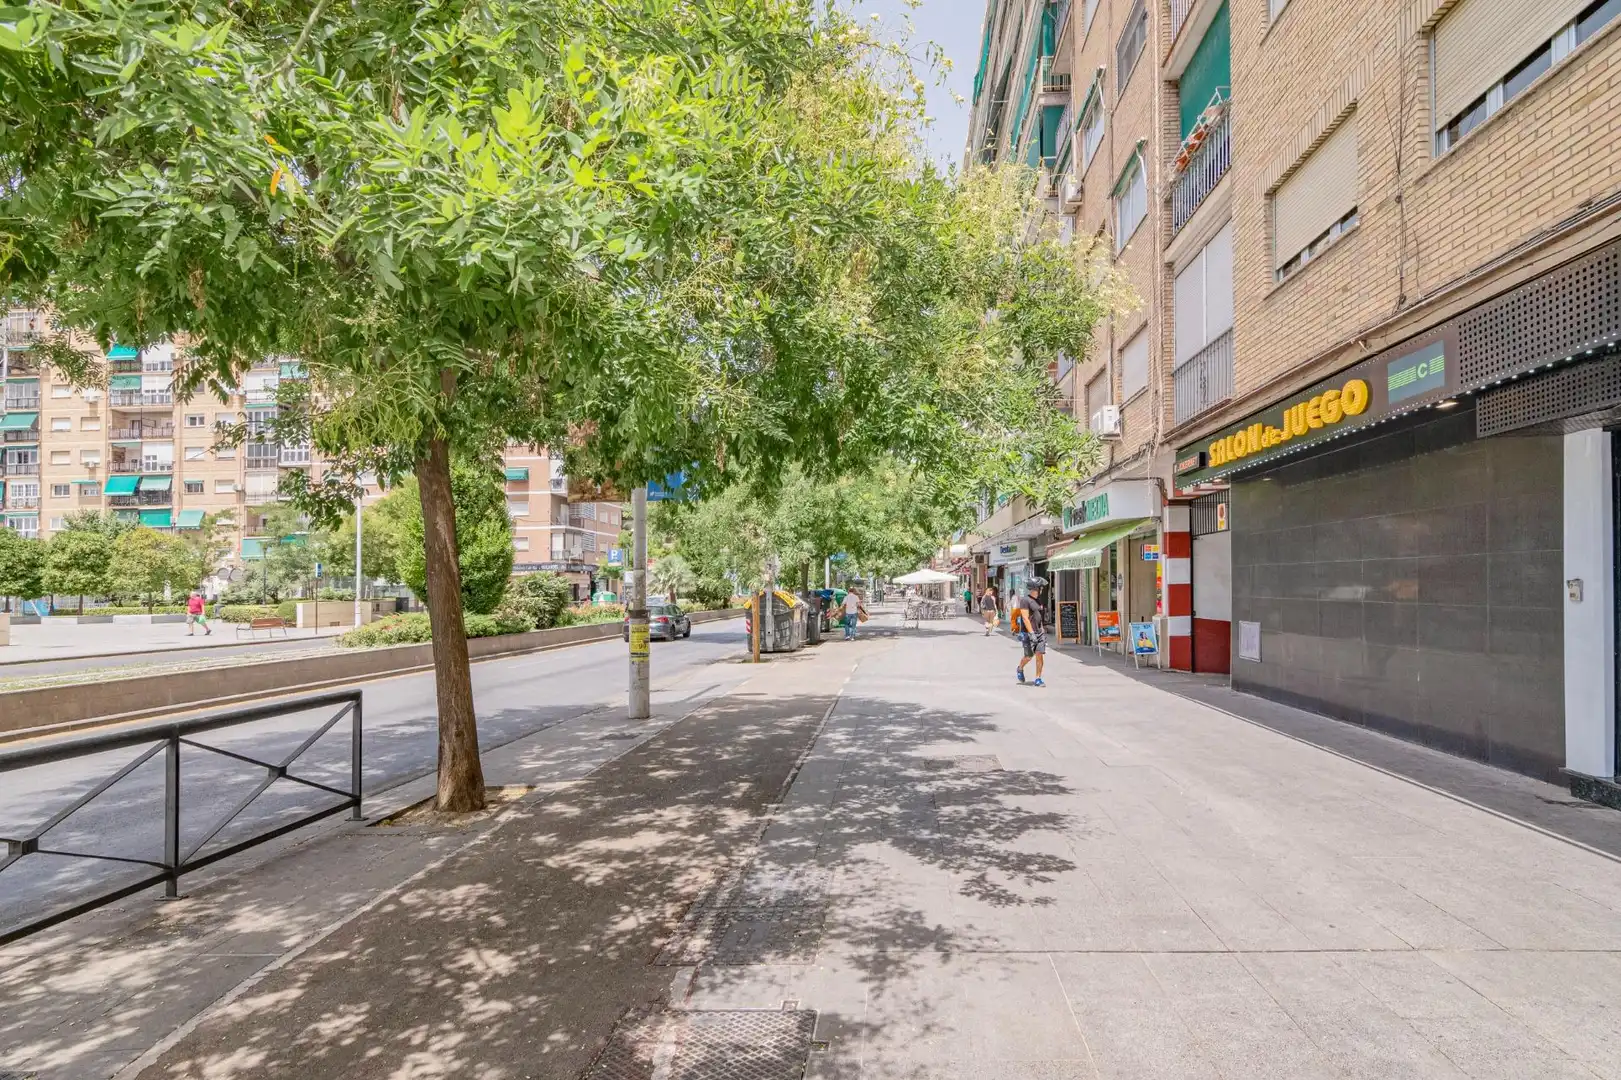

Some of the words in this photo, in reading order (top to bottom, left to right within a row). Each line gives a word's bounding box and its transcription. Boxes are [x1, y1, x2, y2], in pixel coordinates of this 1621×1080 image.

[1209, 422, 1263, 468] SALON
[1261, 425, 1282, 448] de
[1280, 379, 1370, 441] JUEGO
